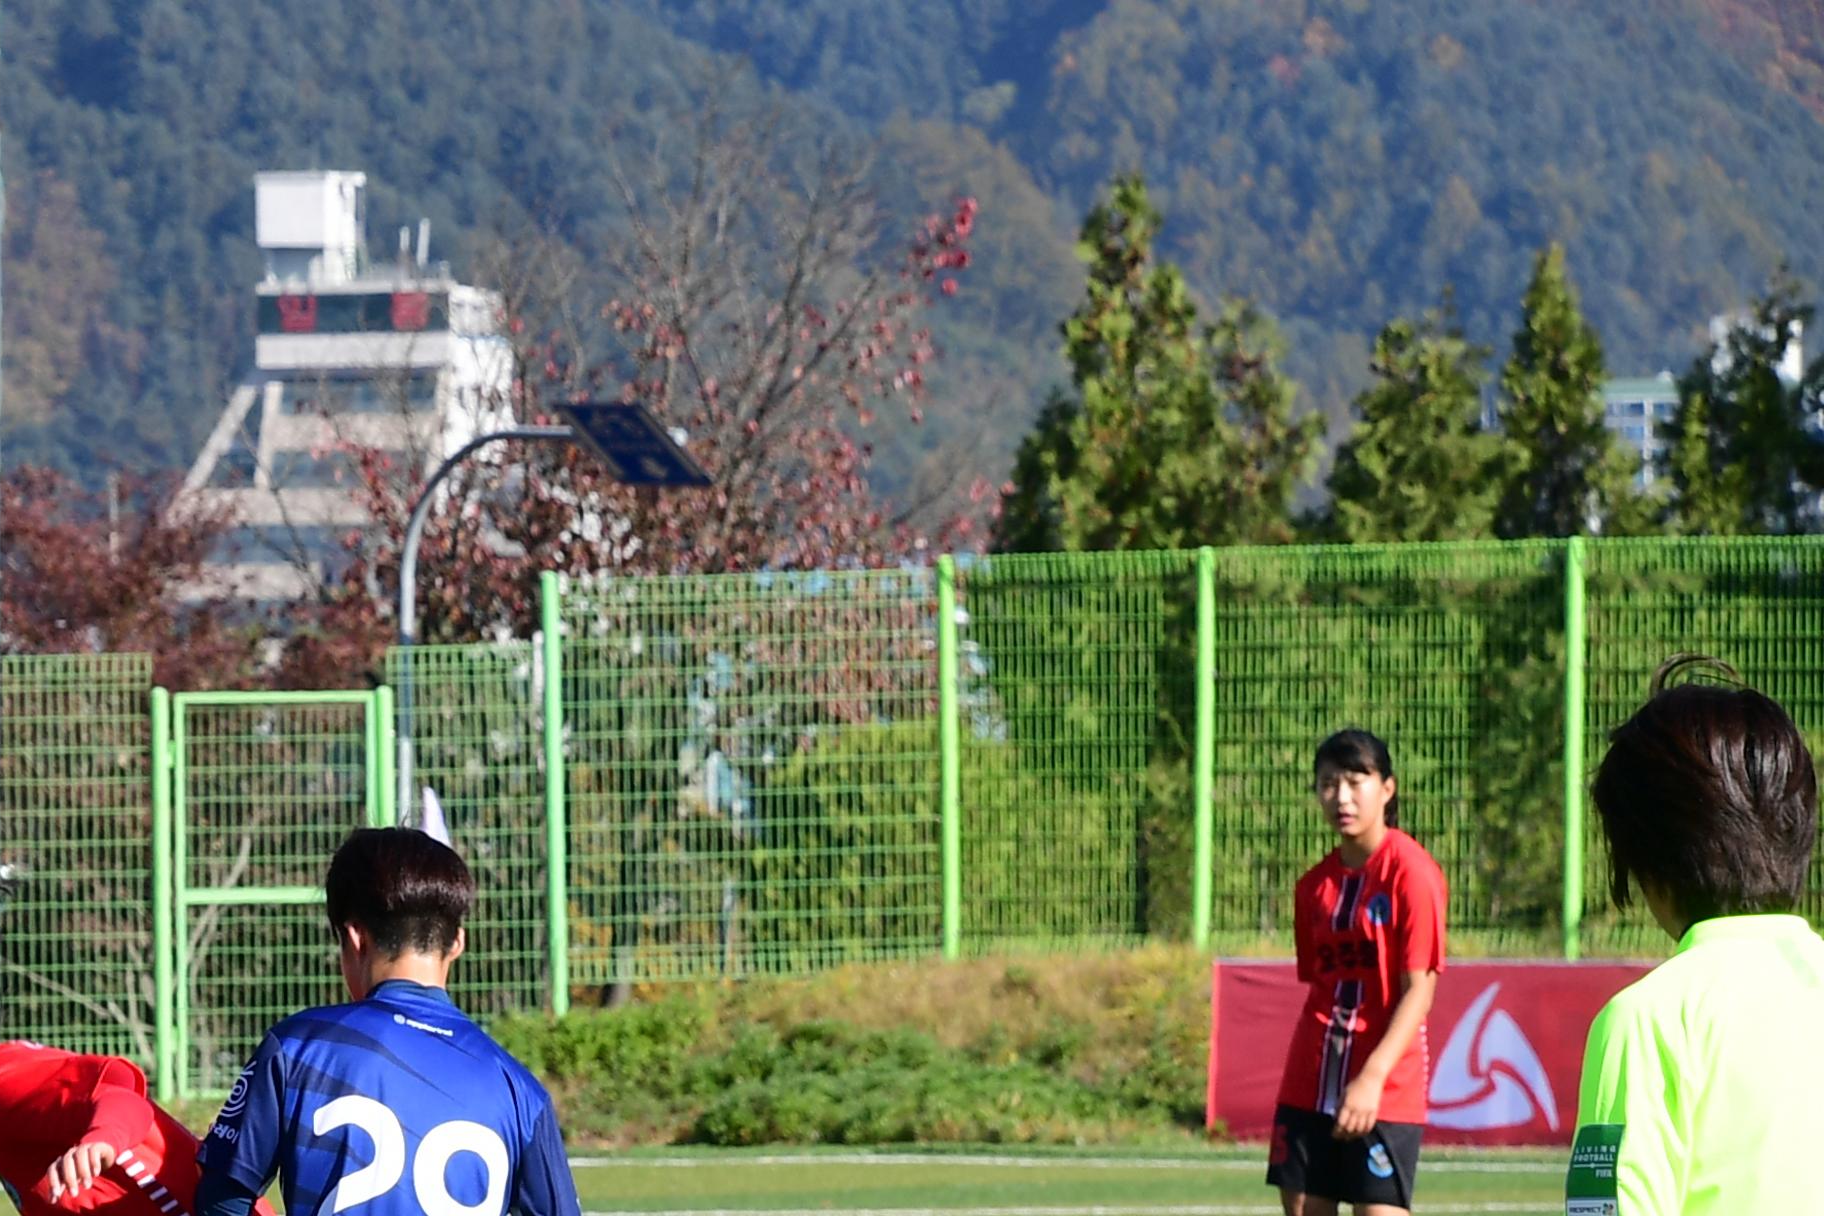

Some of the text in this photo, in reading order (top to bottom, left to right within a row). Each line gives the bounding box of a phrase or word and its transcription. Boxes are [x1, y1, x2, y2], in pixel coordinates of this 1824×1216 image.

[1576, 1145, 1616, 1154] LIVING
[1574, 1153, 1614, 1163] FOOTBALL
[1569, 1206, 1601, 1214] RESPECT
